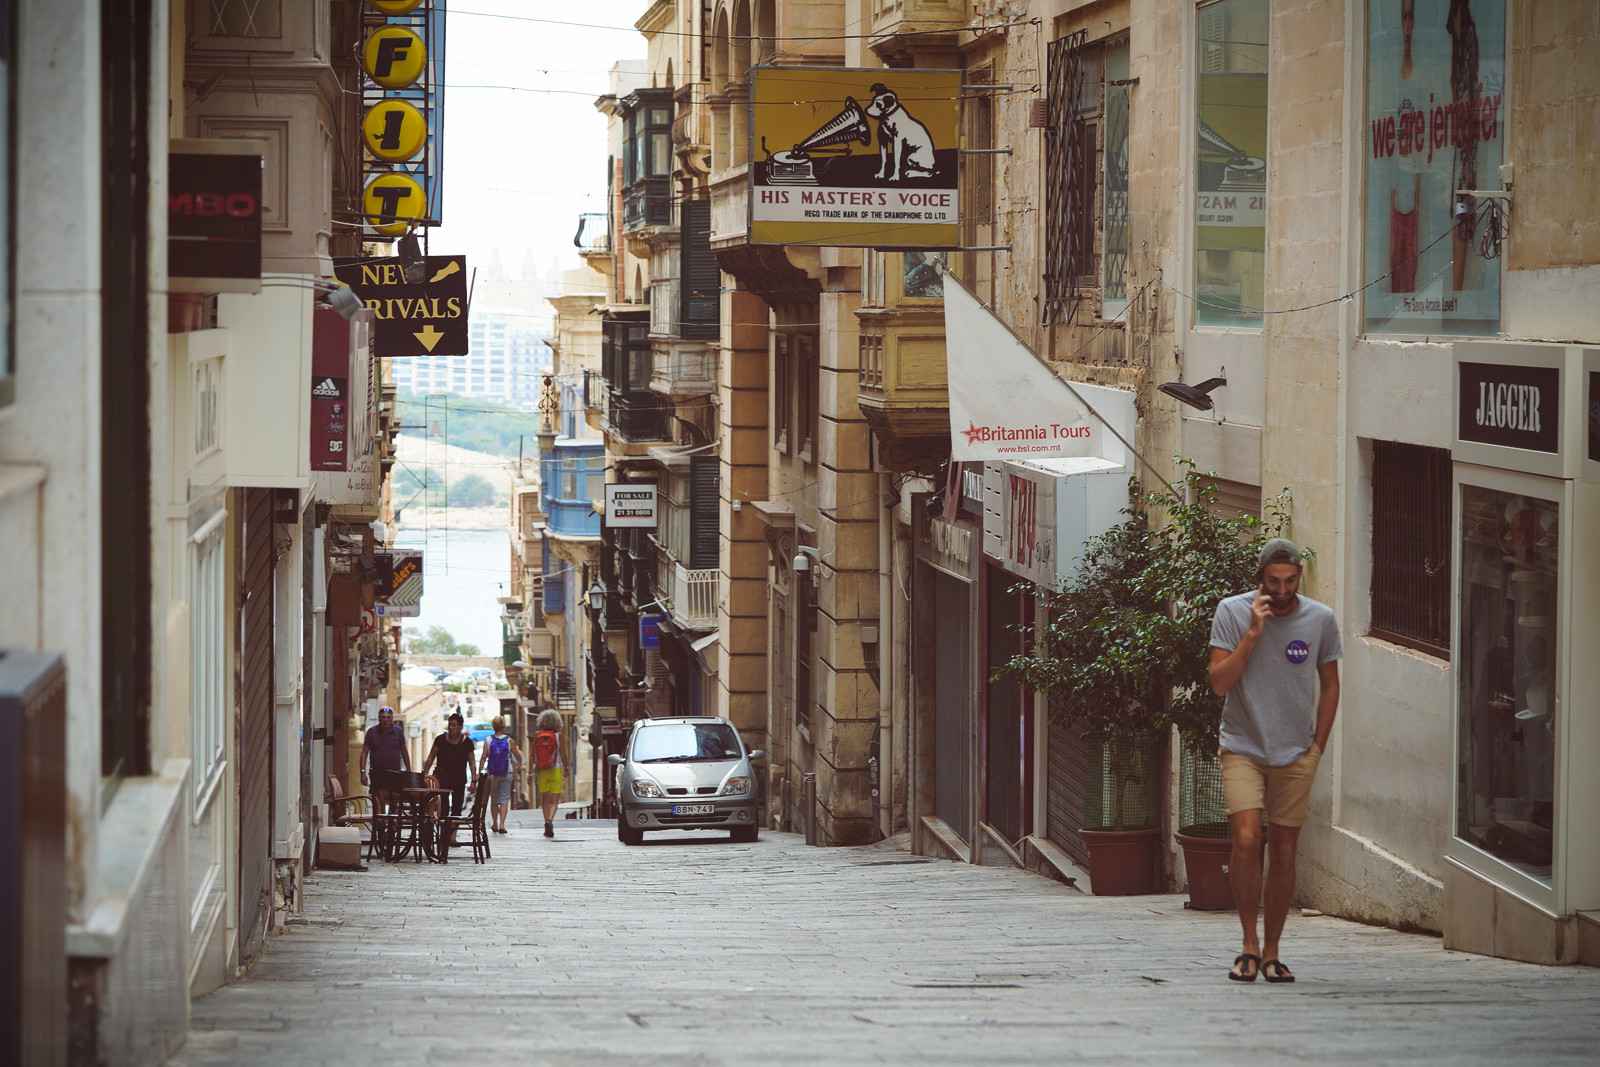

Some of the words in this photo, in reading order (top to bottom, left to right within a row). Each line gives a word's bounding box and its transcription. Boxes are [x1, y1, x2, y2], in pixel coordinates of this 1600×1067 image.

[1372, 115, 1395, 160] we
[1398, 109, 1425, 156] are
[761, 190, 790, 204] HIS
[801, 191, 887, 206] MASTER'S
[899, 193, 950, 207] VOICE
[822, 210, 842, 218] TRADE
[843, 211, 859, 219] MARK
[861, 211, 870, 219] OF
[871, 211, 883, 219] THE
[365, 297, 461, 319] RIVALS
[313, 388, 340, 396] adidas
[1476, 382, 1541, 433] JAGGER
[981, 424, 1047, 441] Britannia
[1050, 424, 1091, 439] Tours
